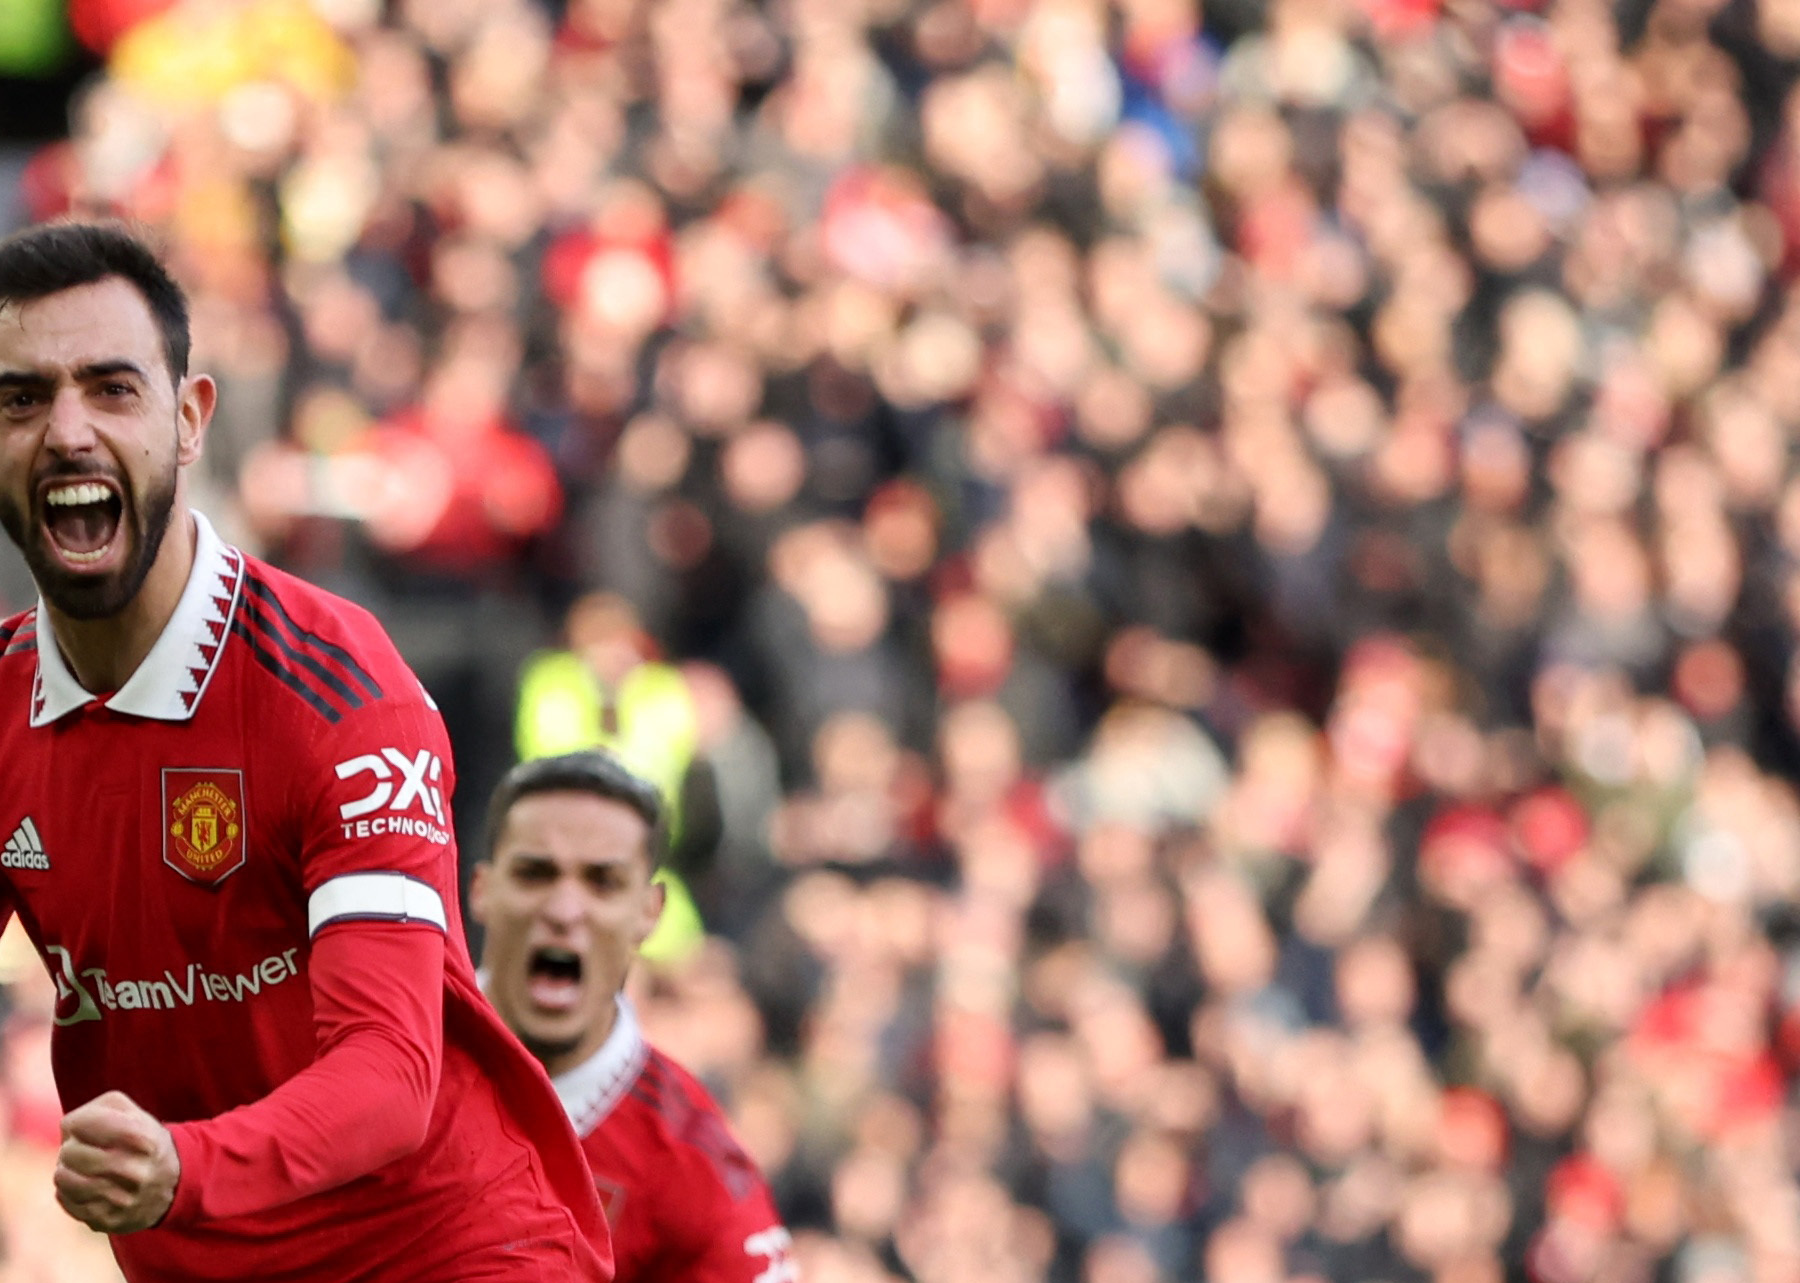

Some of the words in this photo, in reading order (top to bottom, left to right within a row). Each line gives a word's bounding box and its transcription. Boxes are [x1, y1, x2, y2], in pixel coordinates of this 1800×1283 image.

[178, 788, 232, 816] MANCHESTER
[0, 850, 50, 870] adidas
[186, 849, 224, 863] UNITED
[81, 947, 299, 1010] TeamViewer
